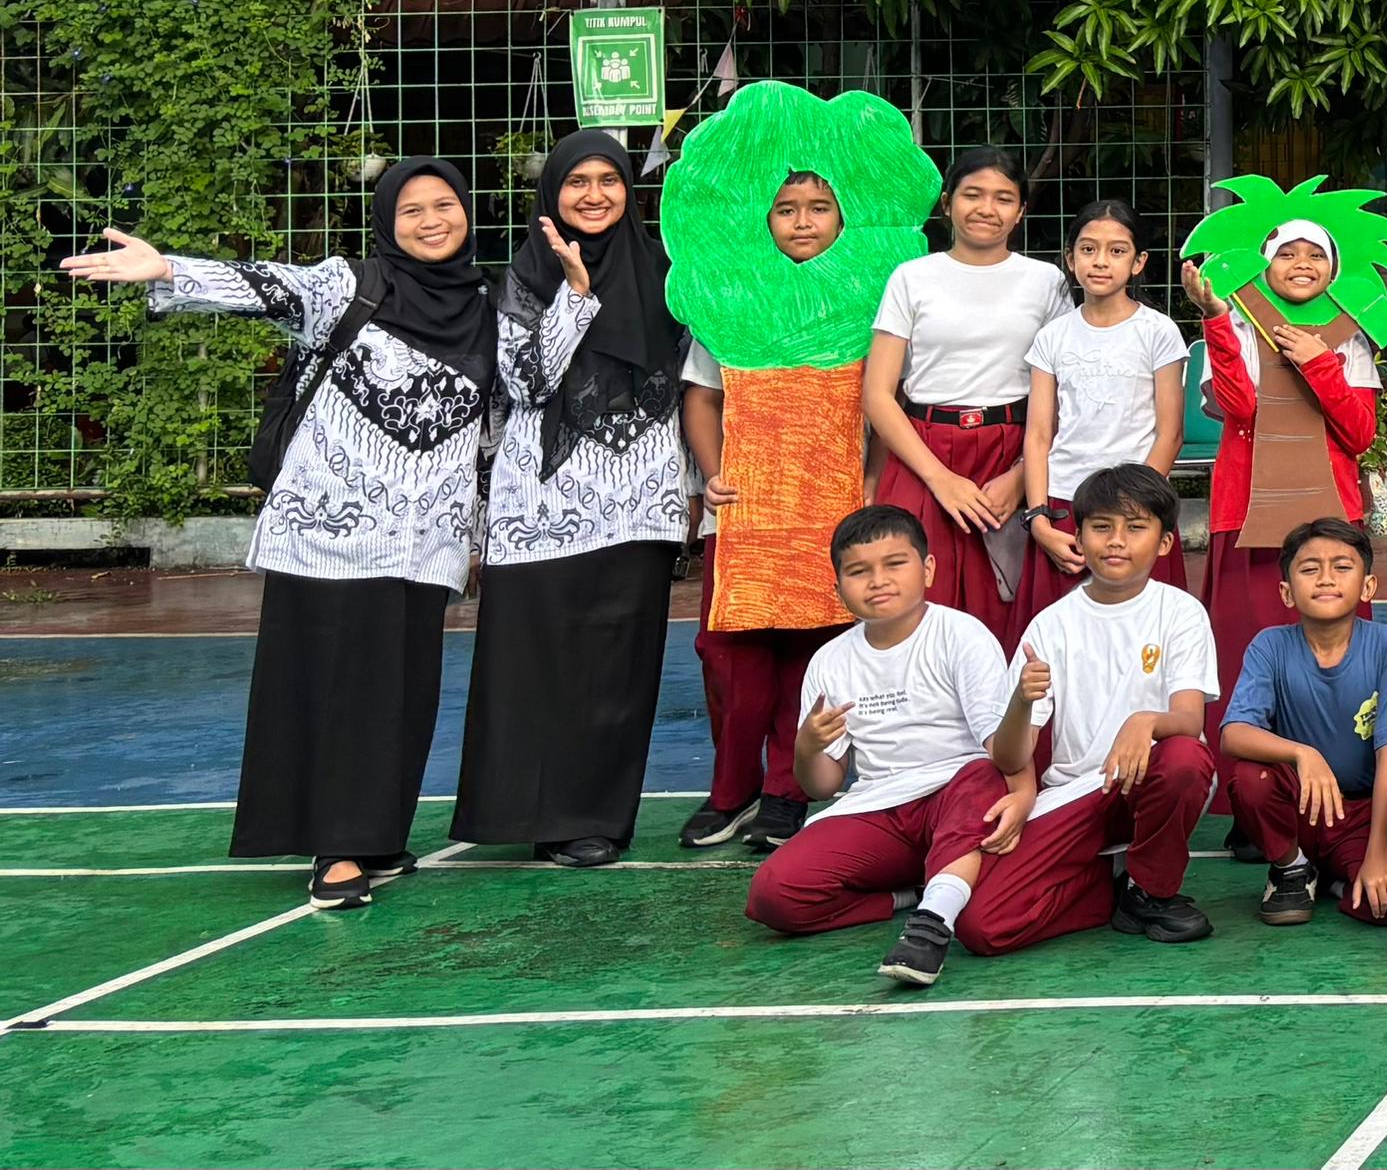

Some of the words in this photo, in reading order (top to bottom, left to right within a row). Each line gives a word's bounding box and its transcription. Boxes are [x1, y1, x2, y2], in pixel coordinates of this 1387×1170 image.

[584, 17, 606, 29] TITIK
[607, 16, 648, 28] KUMPUL
[629, 104, 657, 116] POINT
